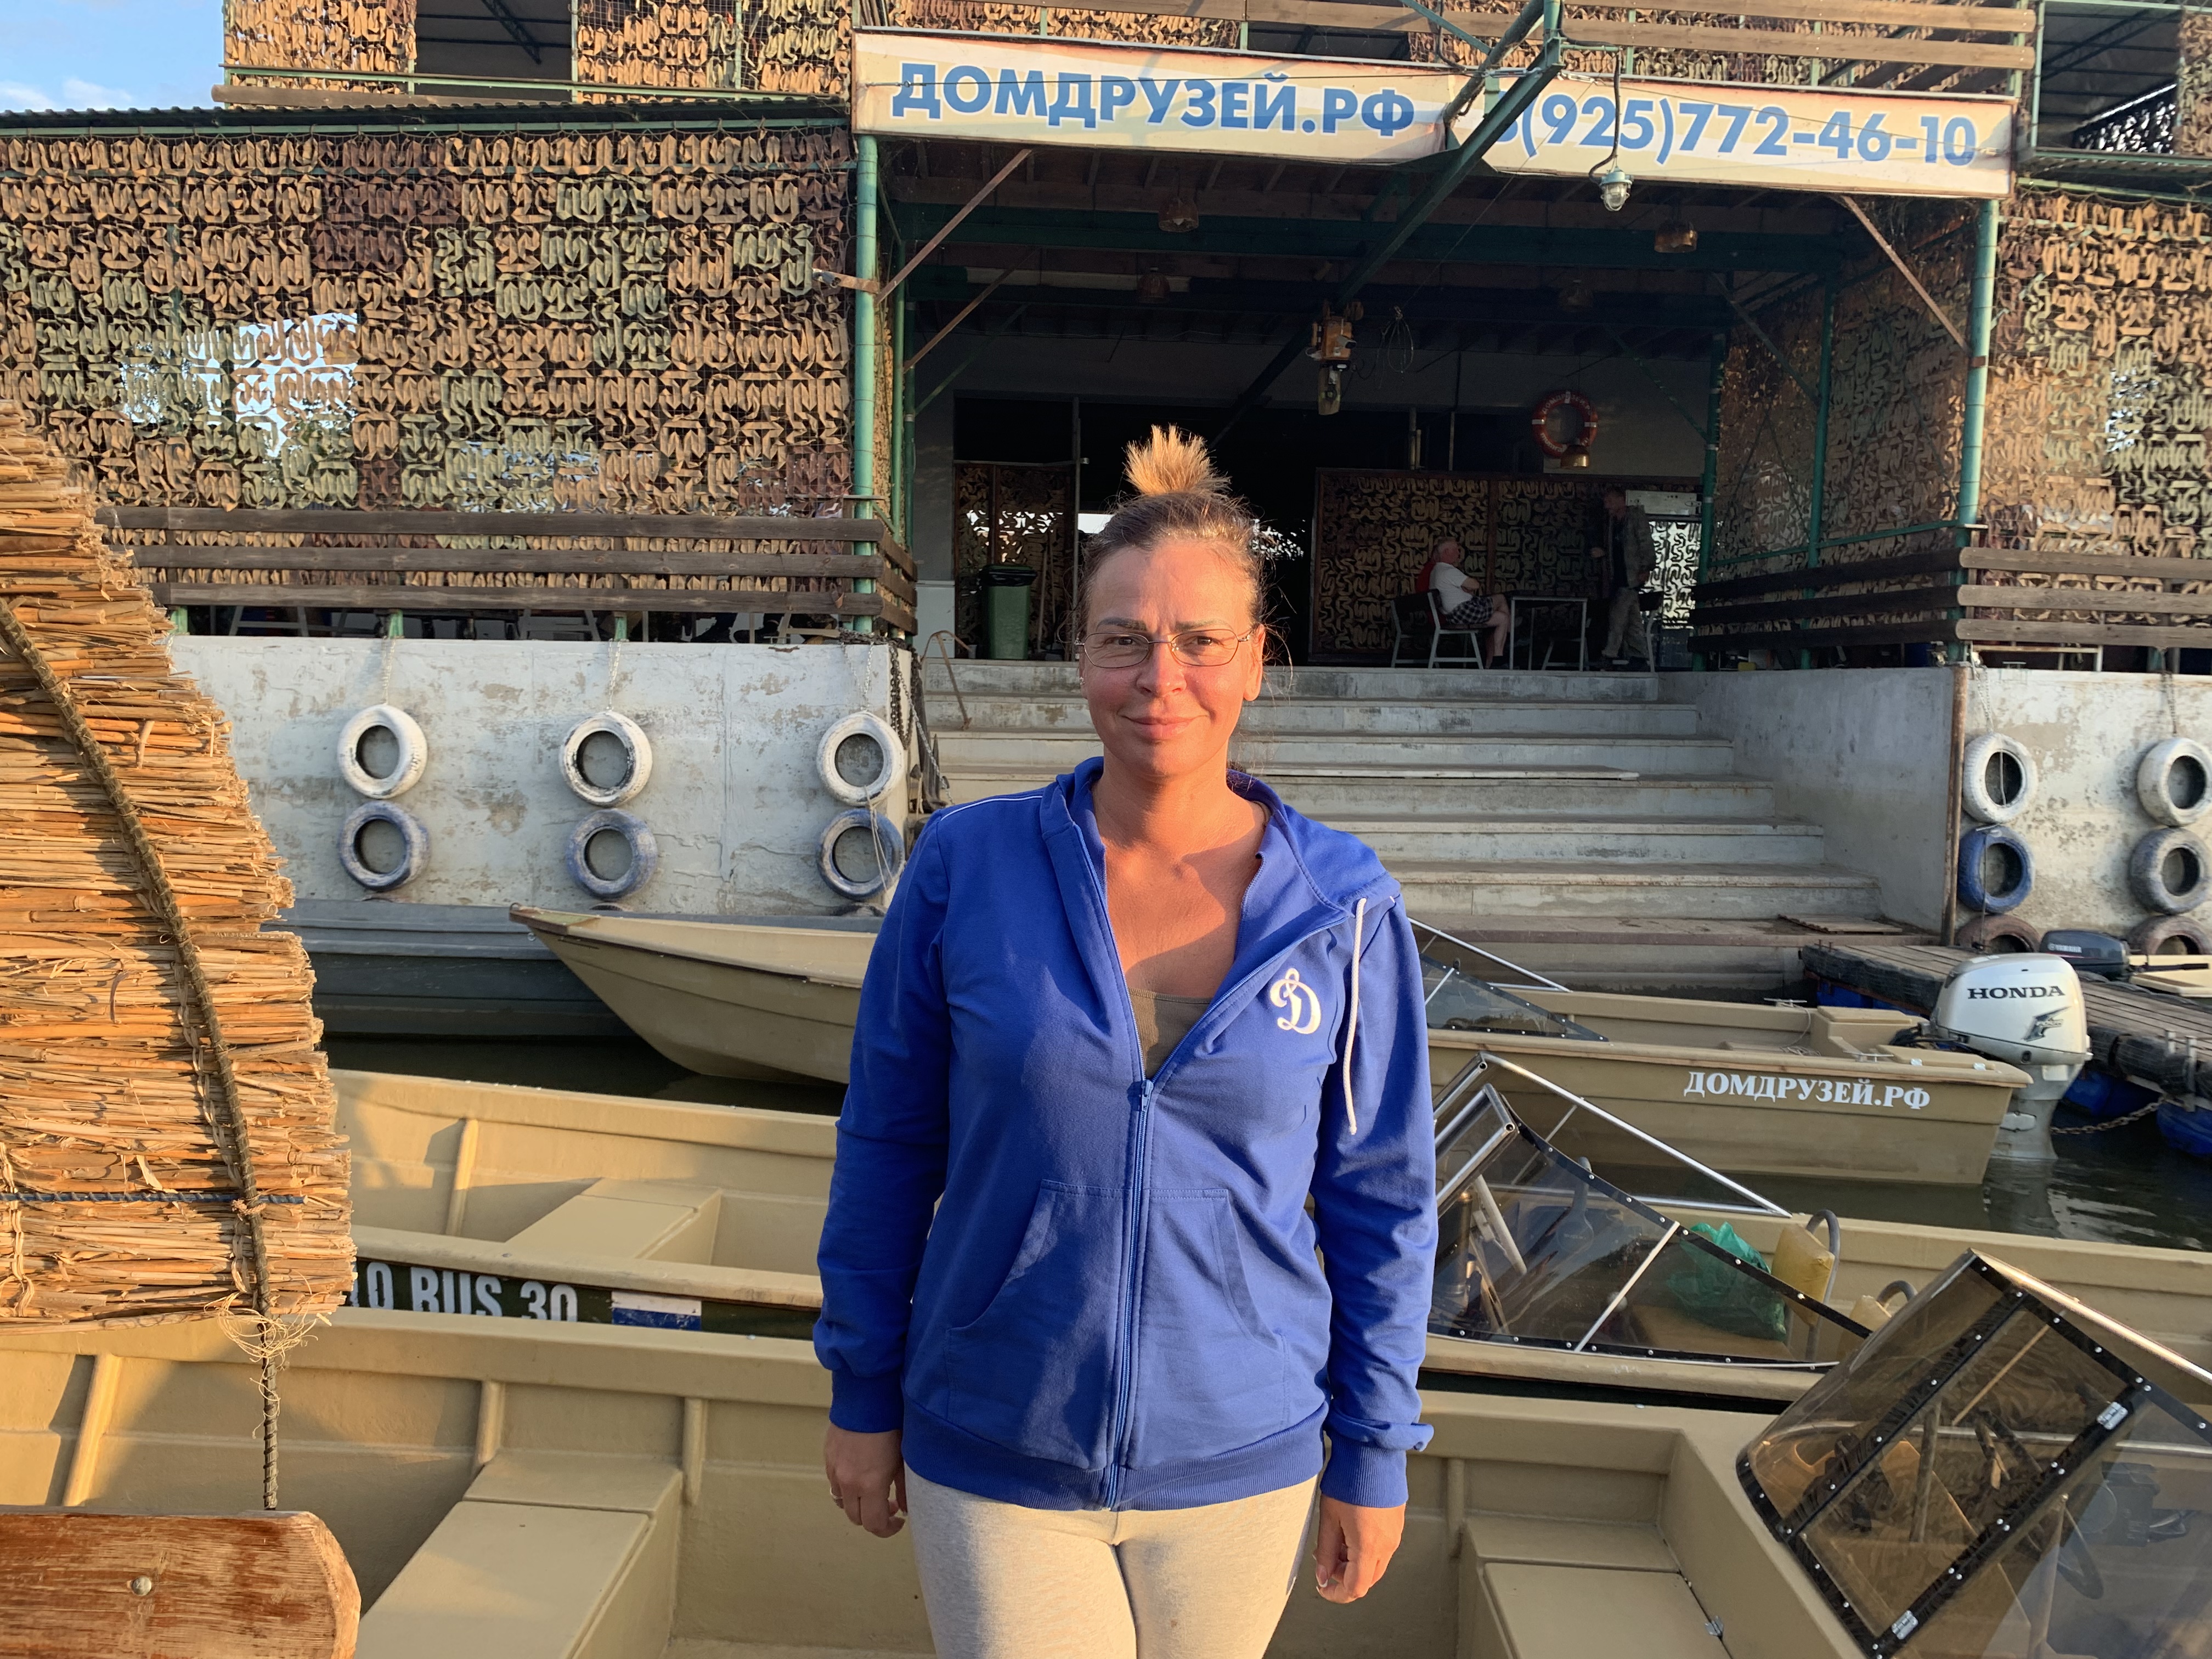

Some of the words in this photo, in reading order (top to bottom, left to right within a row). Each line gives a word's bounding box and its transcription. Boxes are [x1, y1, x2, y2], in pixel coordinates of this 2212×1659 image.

[891, 62, 1415, 137] ДОМДРУЗЕЙ.РФ
[1967, 986, 2066, 1000] HONDA
[1684, 1071, 1931, 1110] ДОМДРУЗЕЙ.РФ
[410, 1268, 503, 1317] RUS
[520, 1280, 578, 1322] 30
